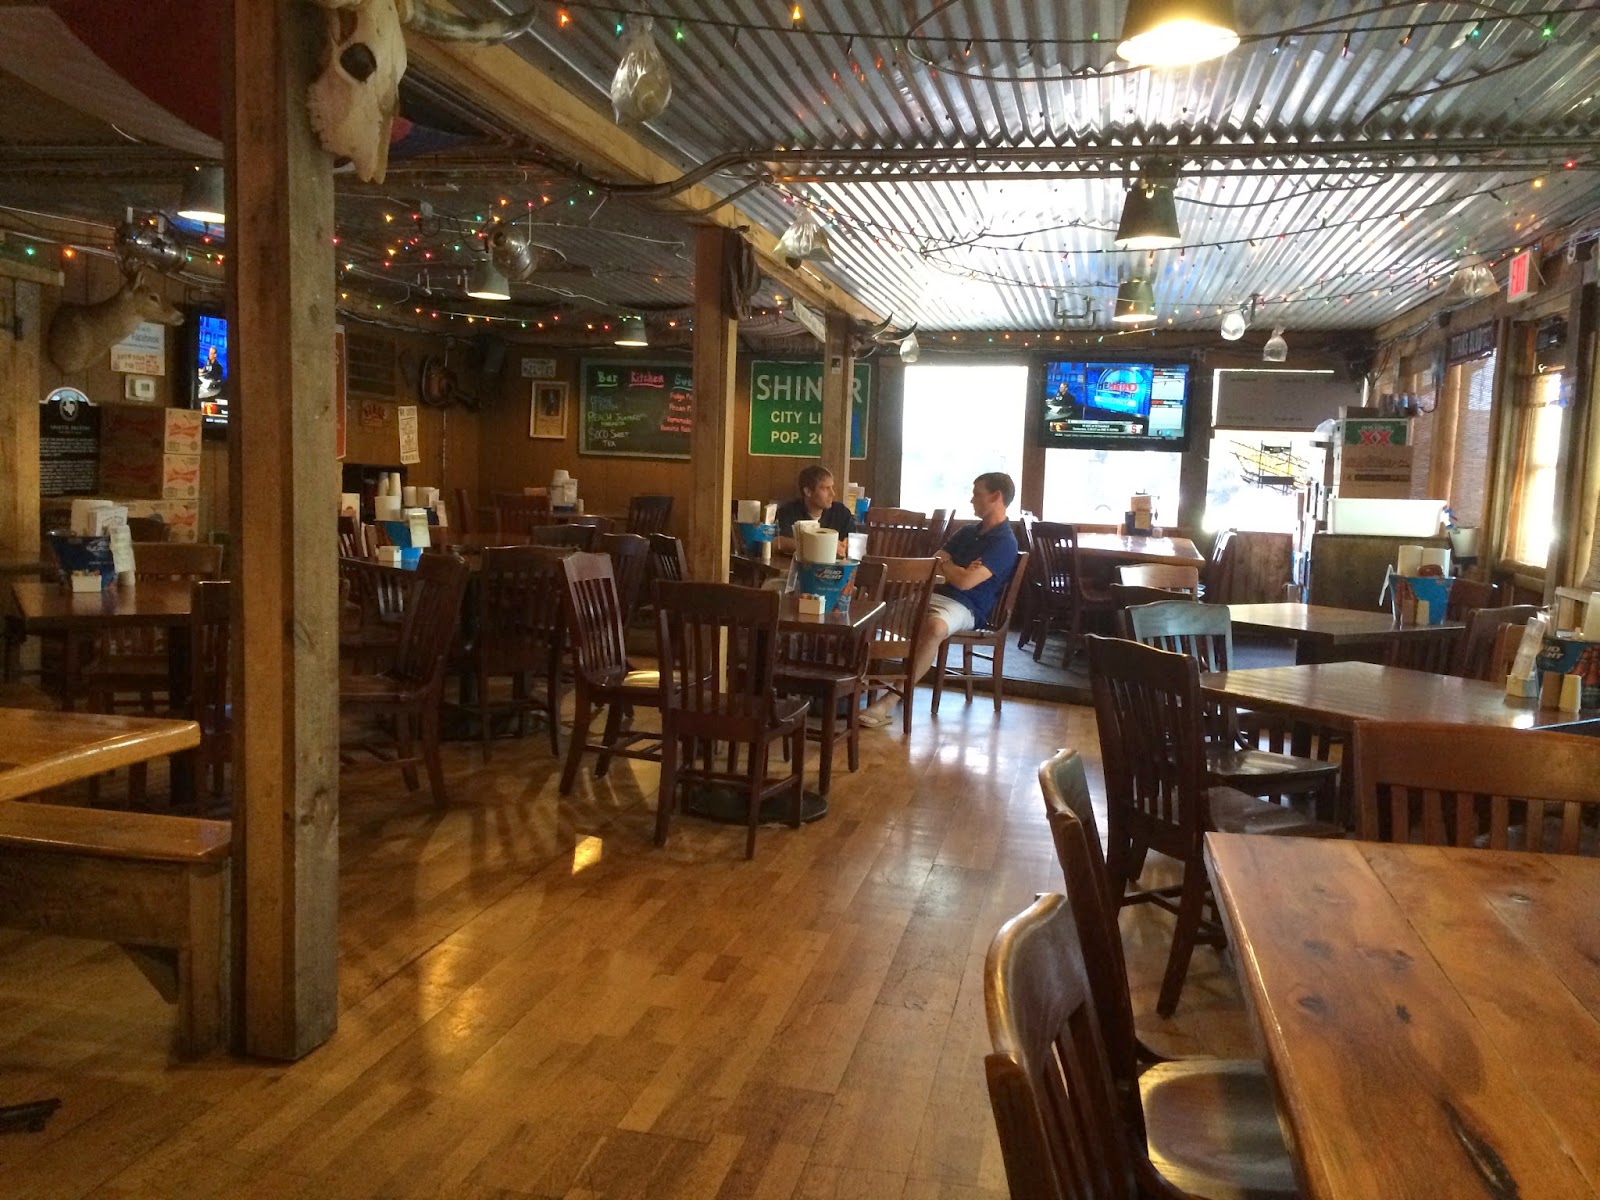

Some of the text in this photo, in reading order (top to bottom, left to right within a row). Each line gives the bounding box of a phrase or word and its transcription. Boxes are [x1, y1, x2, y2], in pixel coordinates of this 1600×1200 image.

[597, 371, 618, 383] Bar
[630, 371, 664, 384] Kitchen
[756, 374, 863, 404] SHINR
[770, 411, 803, 424] CITY
[770, 431, 803, 444] POP.
